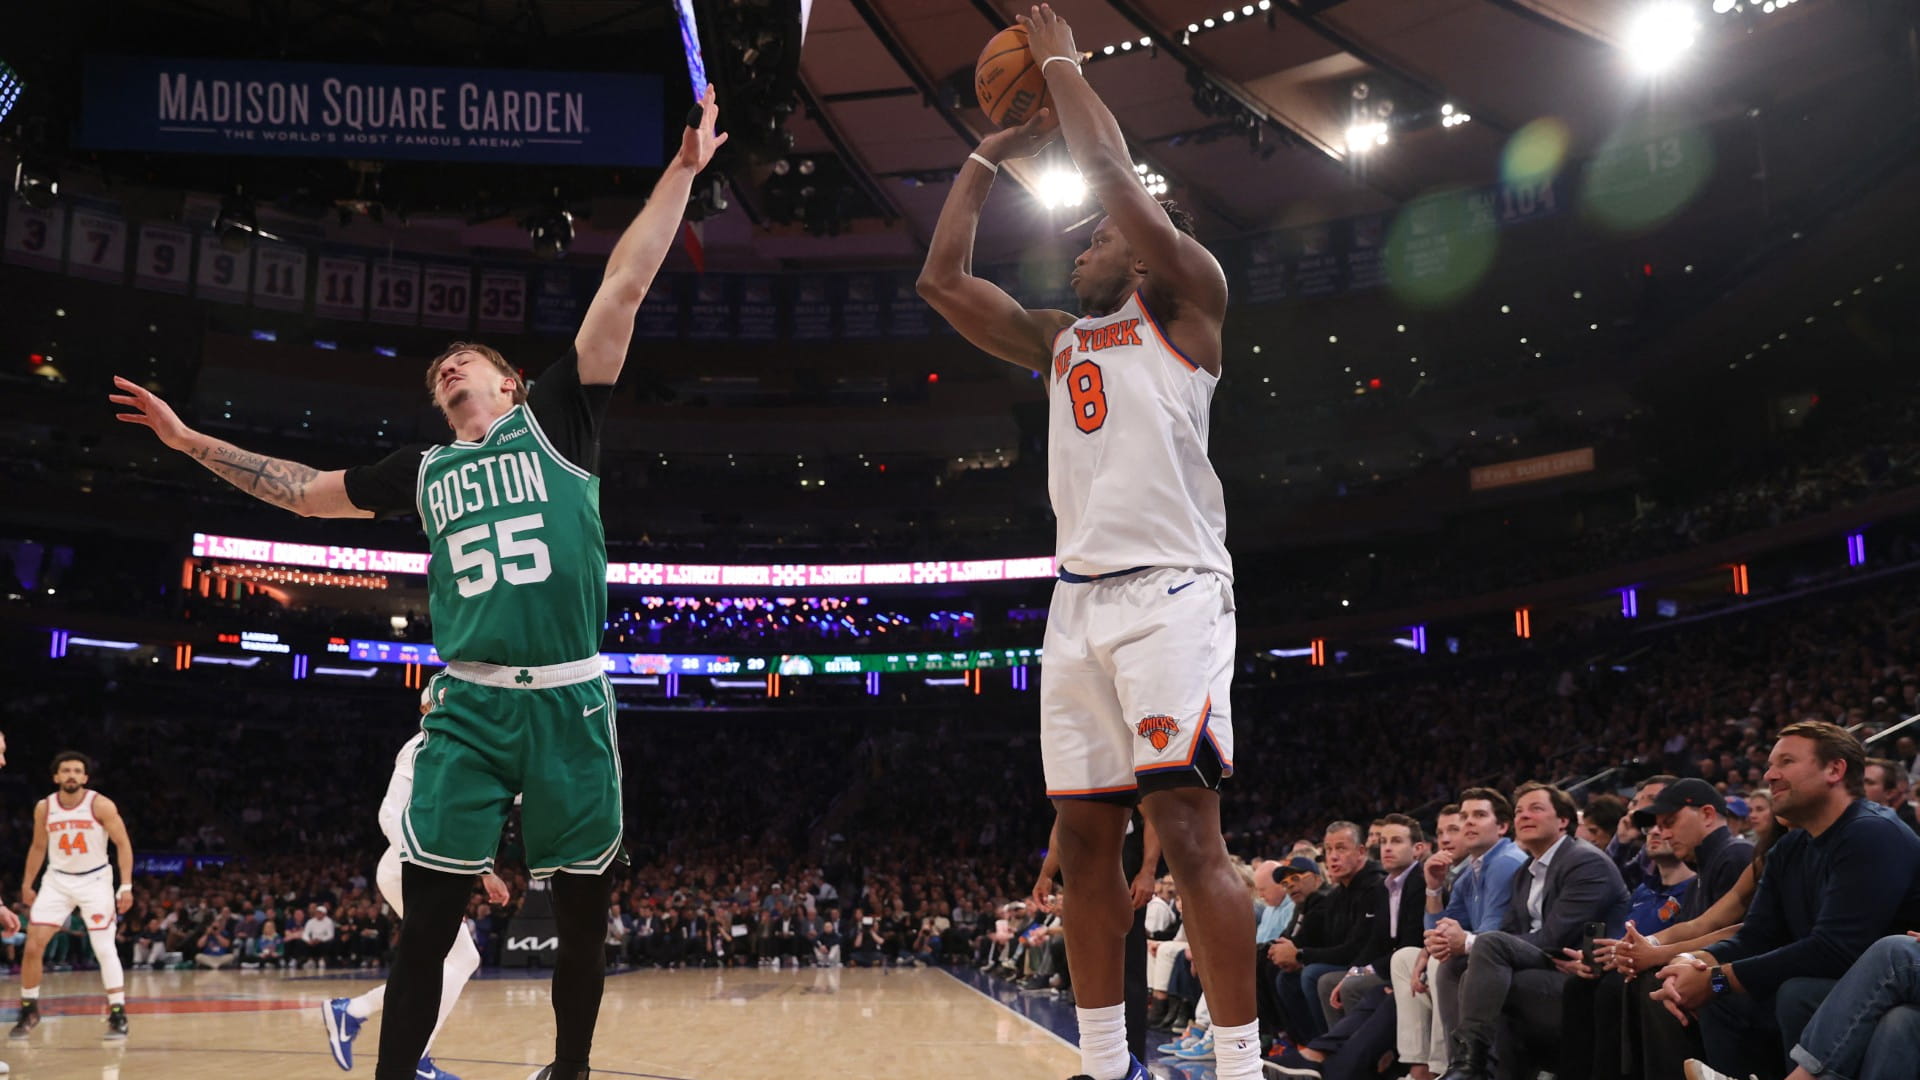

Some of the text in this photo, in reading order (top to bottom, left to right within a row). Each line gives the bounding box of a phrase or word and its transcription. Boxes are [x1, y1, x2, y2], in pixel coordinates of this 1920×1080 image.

[159, 72, 584, 133] MADISON SQUARE GARDEN
[224, 129, 255, 140] THE
[263, 131, 336, 143] WORLD'S
[343, 134, 388, 144] MOST
[396, 135, 461, 146] FAMOUS
[21, 219, 47, 251] 3
[86, 231, 111, 264] 7
[152, 243, 176, 275] 9
[212, 254, 235, 285] 9
[264, 262, 295, 297] 11
[324, 272, 355, 305] 11
[377, 277, 413, 309] 19
[428, 284, 467, 314] 30
[483, 287, 522, 317] 35
[1055, 319, 1143, 385] NE YORK
[1066, 358, 1108, 435] 8
[496, 426, 529, 446] Amica
[427, 451, 549, 535] BOSTON
[446, 513, 553, 599] 55
[747, 658, 765, 670] 29
[1138, 716, 1179, 736] KNICKS
[58, 831, 88, 856] 44
[507, 936, 559, 951] KIA
